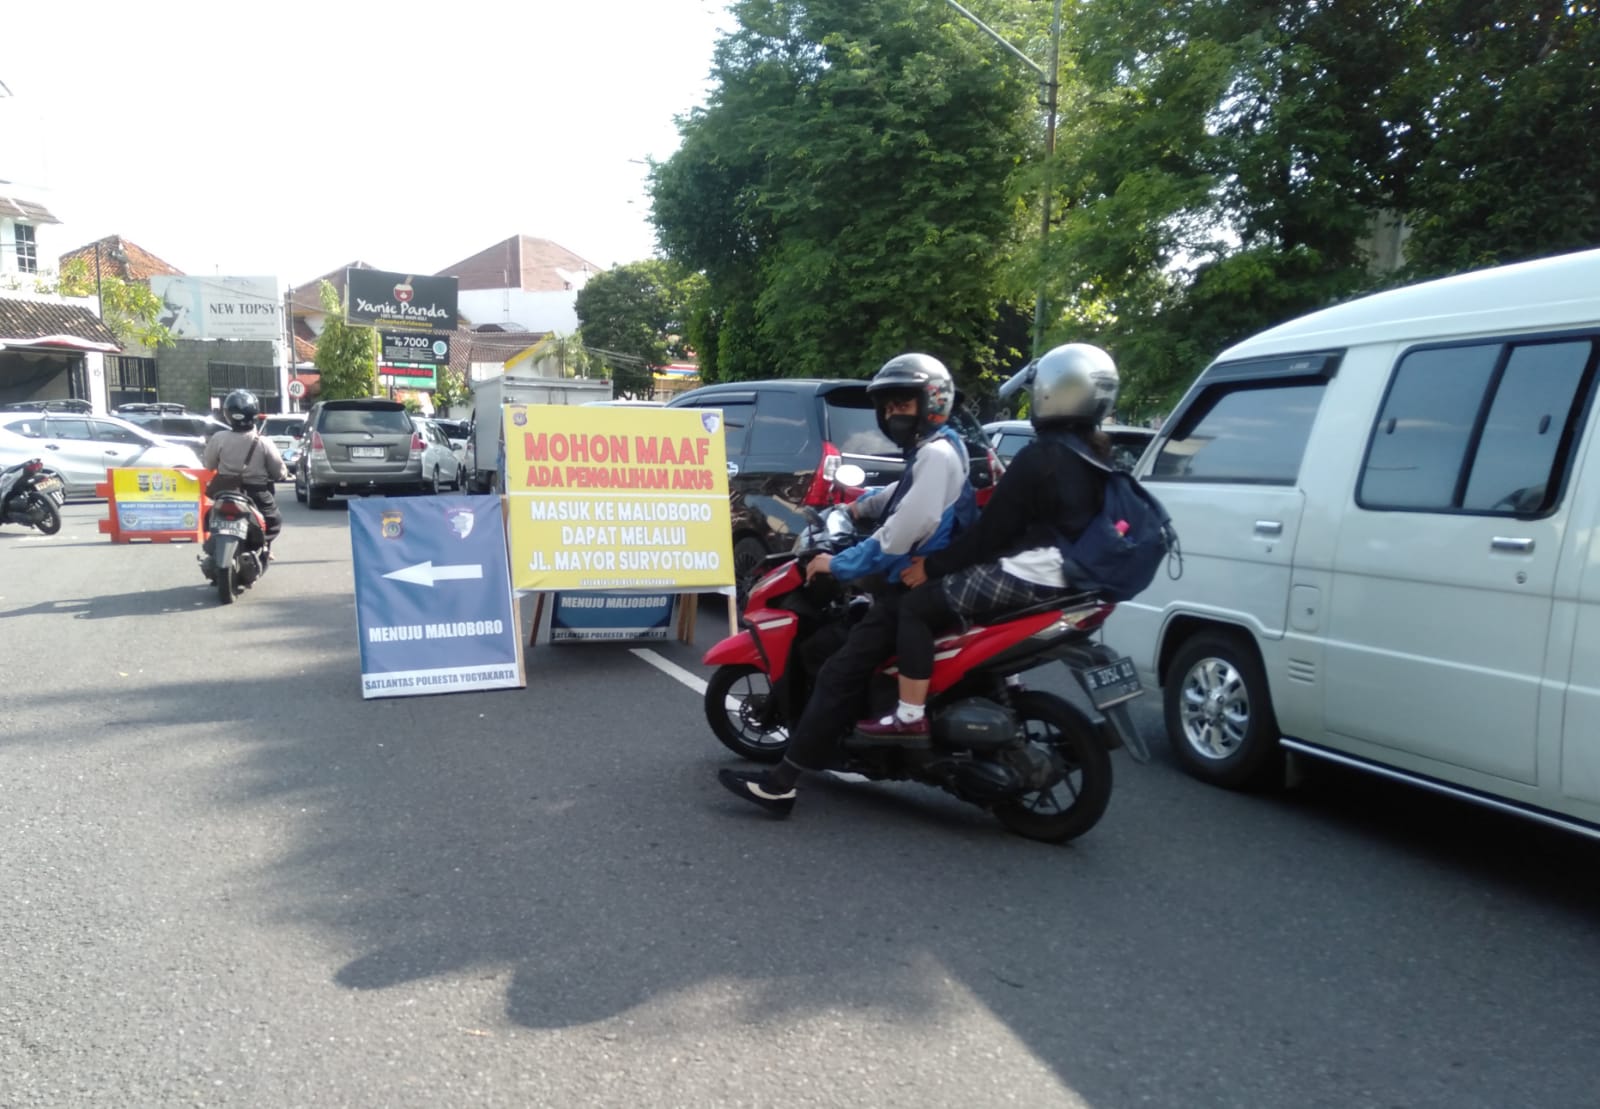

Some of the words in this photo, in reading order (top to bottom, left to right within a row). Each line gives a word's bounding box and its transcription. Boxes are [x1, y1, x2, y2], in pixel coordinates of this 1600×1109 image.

[209, 303, 235, 314] NEW
[239, 303, 276, 314] TOPSY
[400, 301, 449, 318] Panda
[403, 337, 429, 348] 7000
[290, 384, 301, 394] 40
[524, 432, 629, 463] MOHON
[635, 436, 710, 465] MAAF
[526, 466, 564, 487] ADA
[566, 467, 669, 489] PENGALIHAN
[672, 469, 714, 490] ARUS
[531, 501, 591, 521] MASUK
[595, 502, 614, 521] KE
[618, 502, 712, 521] MALIOBORO
[562, 526, 617, 545] DAPAT
[621, 527, 686, 545] MELALUI
[529, 552, 551, 570] JL.
[555, 552, 615, 570] MAYOR
[619, 551, 720, 570] SURYOTOMO
[561, 597, 605, 608] MENUJU
[605, 596, 667, 608] MALIOBORO
[369, 625, 423, 642] MENUJU
[425, 619, 503, 639] MALIOBORO
[365, 678, 414, 690] SATLANTAS
[416, 674, 458, 687] POLRESTA
[460, 670, 515, 683] YOGYAKARTA
